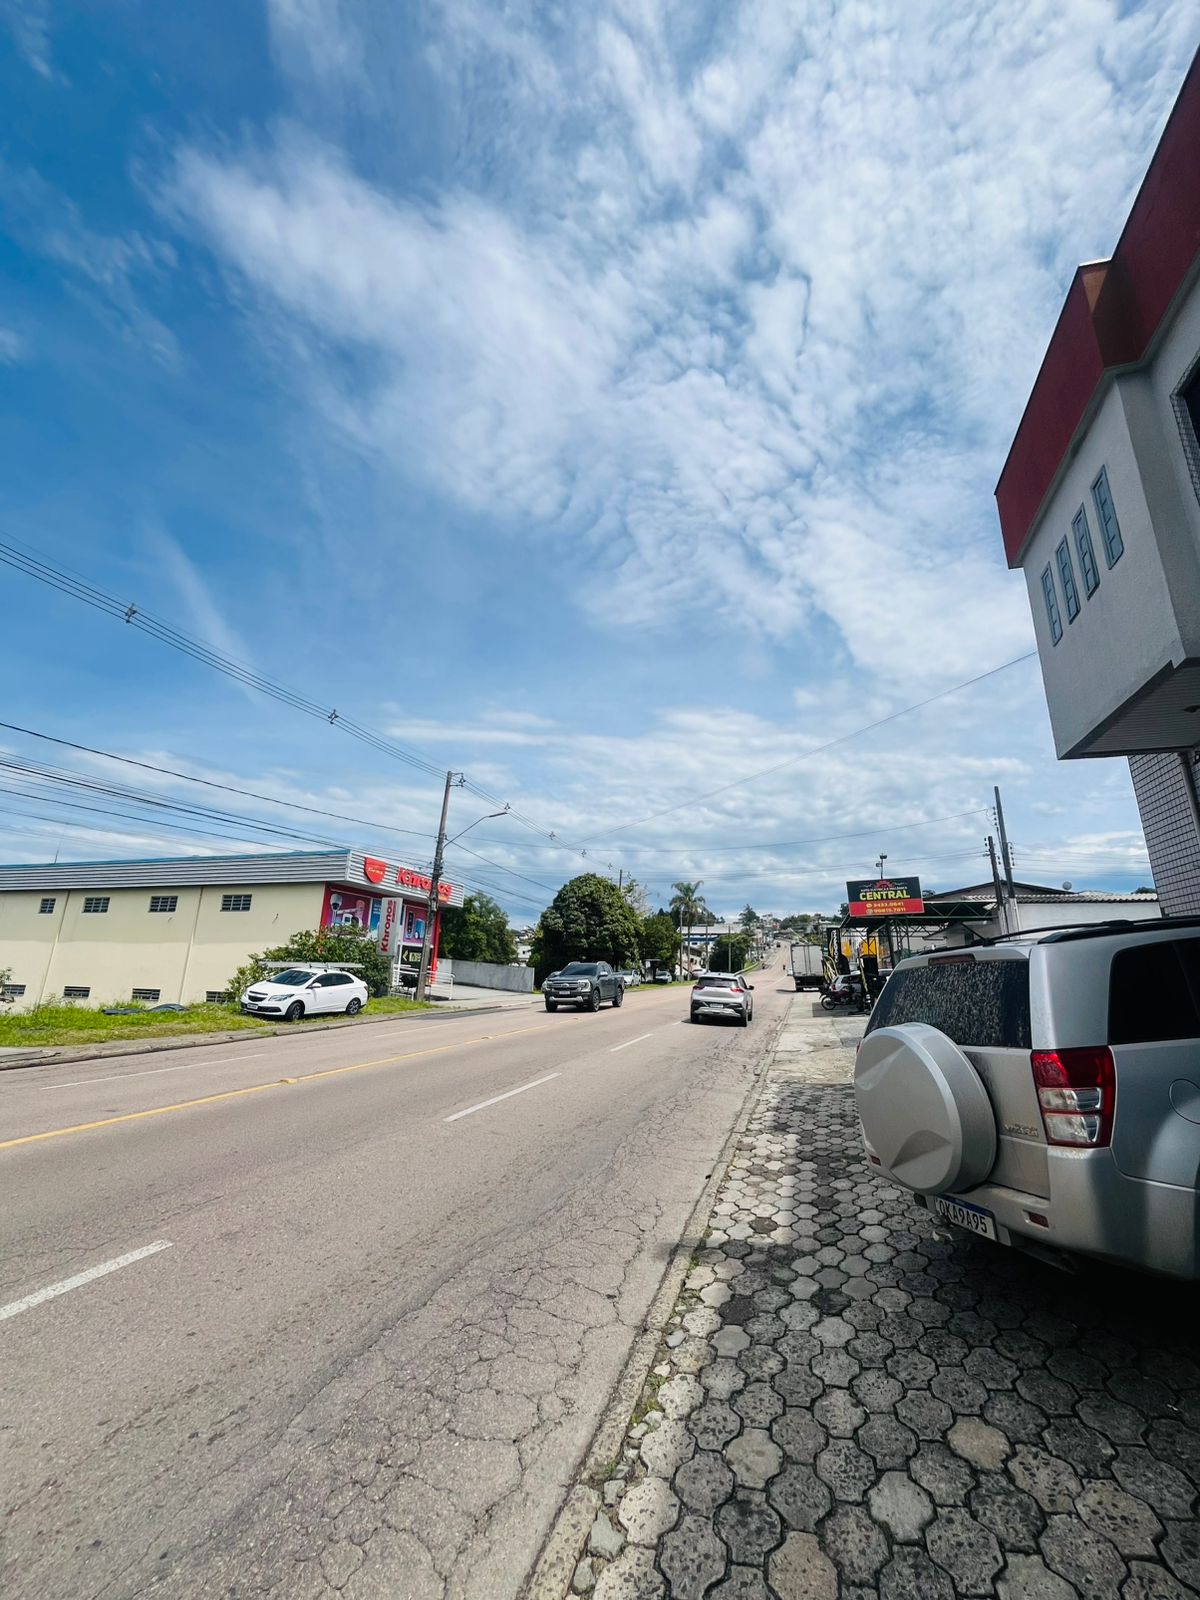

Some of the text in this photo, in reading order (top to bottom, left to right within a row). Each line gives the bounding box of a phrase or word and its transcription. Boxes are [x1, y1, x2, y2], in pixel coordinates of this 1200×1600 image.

[397, 867, 452, 895] Khroos
[859, 890, 911, 901] CENTRAL
[381, 899, 393, 952] Khronos
[939, 1199, 988, 1234] OKA9A95
